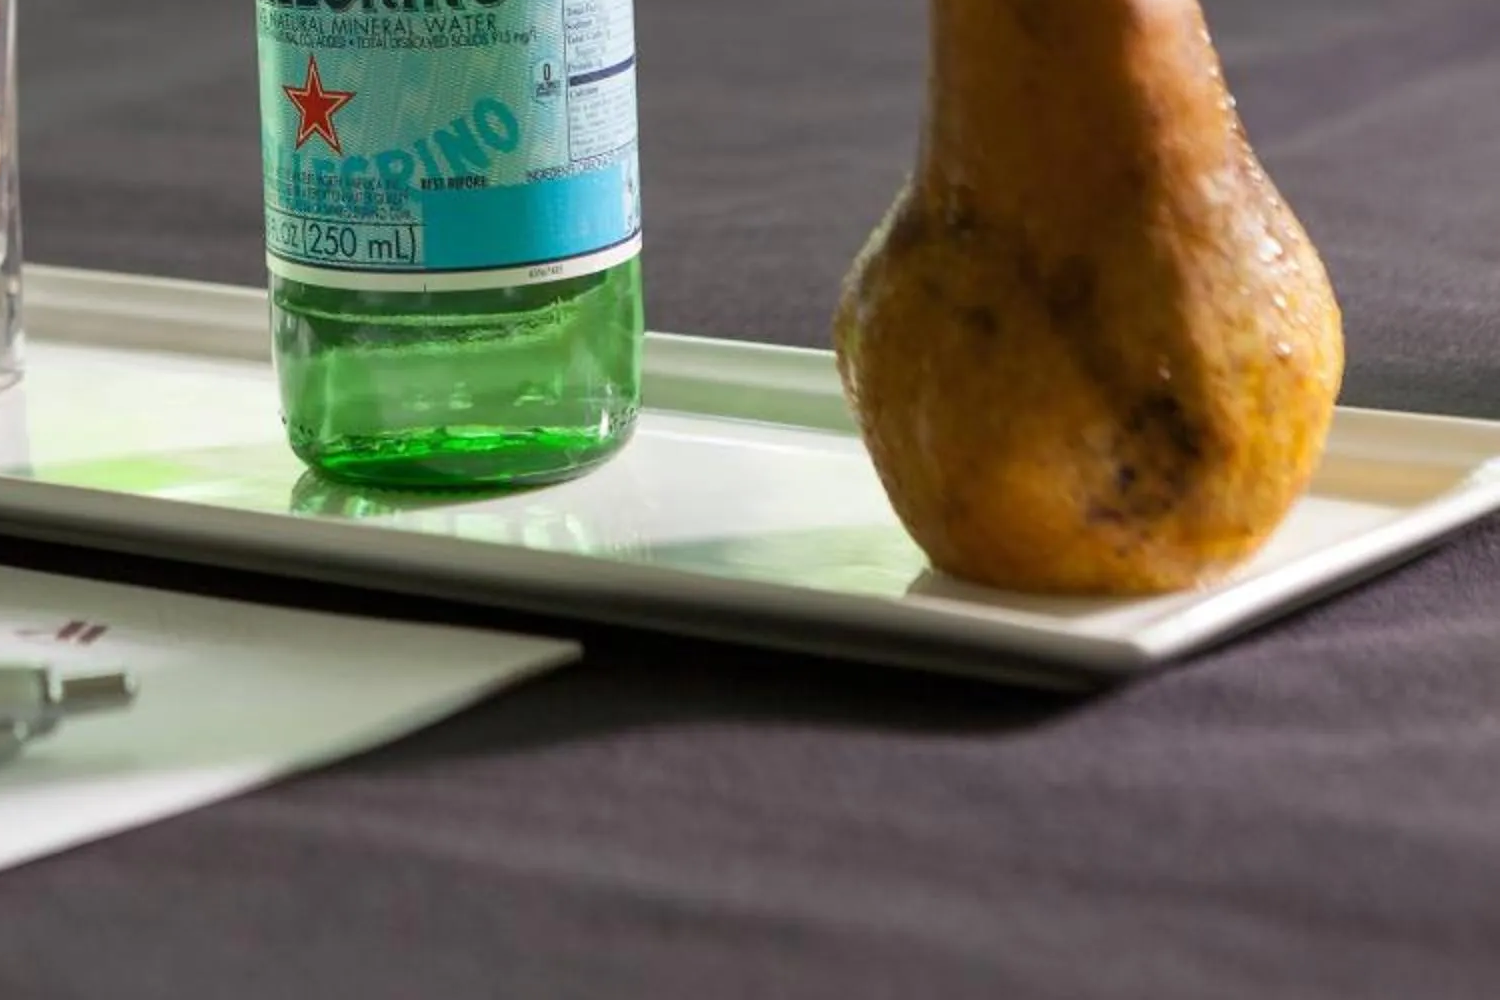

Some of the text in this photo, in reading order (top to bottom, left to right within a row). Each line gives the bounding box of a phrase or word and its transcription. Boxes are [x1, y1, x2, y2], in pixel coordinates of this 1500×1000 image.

[331, 16, 412, 37] MINERAL
[424, 11, 497, 34] WATER
[543, 63, 551, 81] 0
[368, 223, 417, 264] mL)
